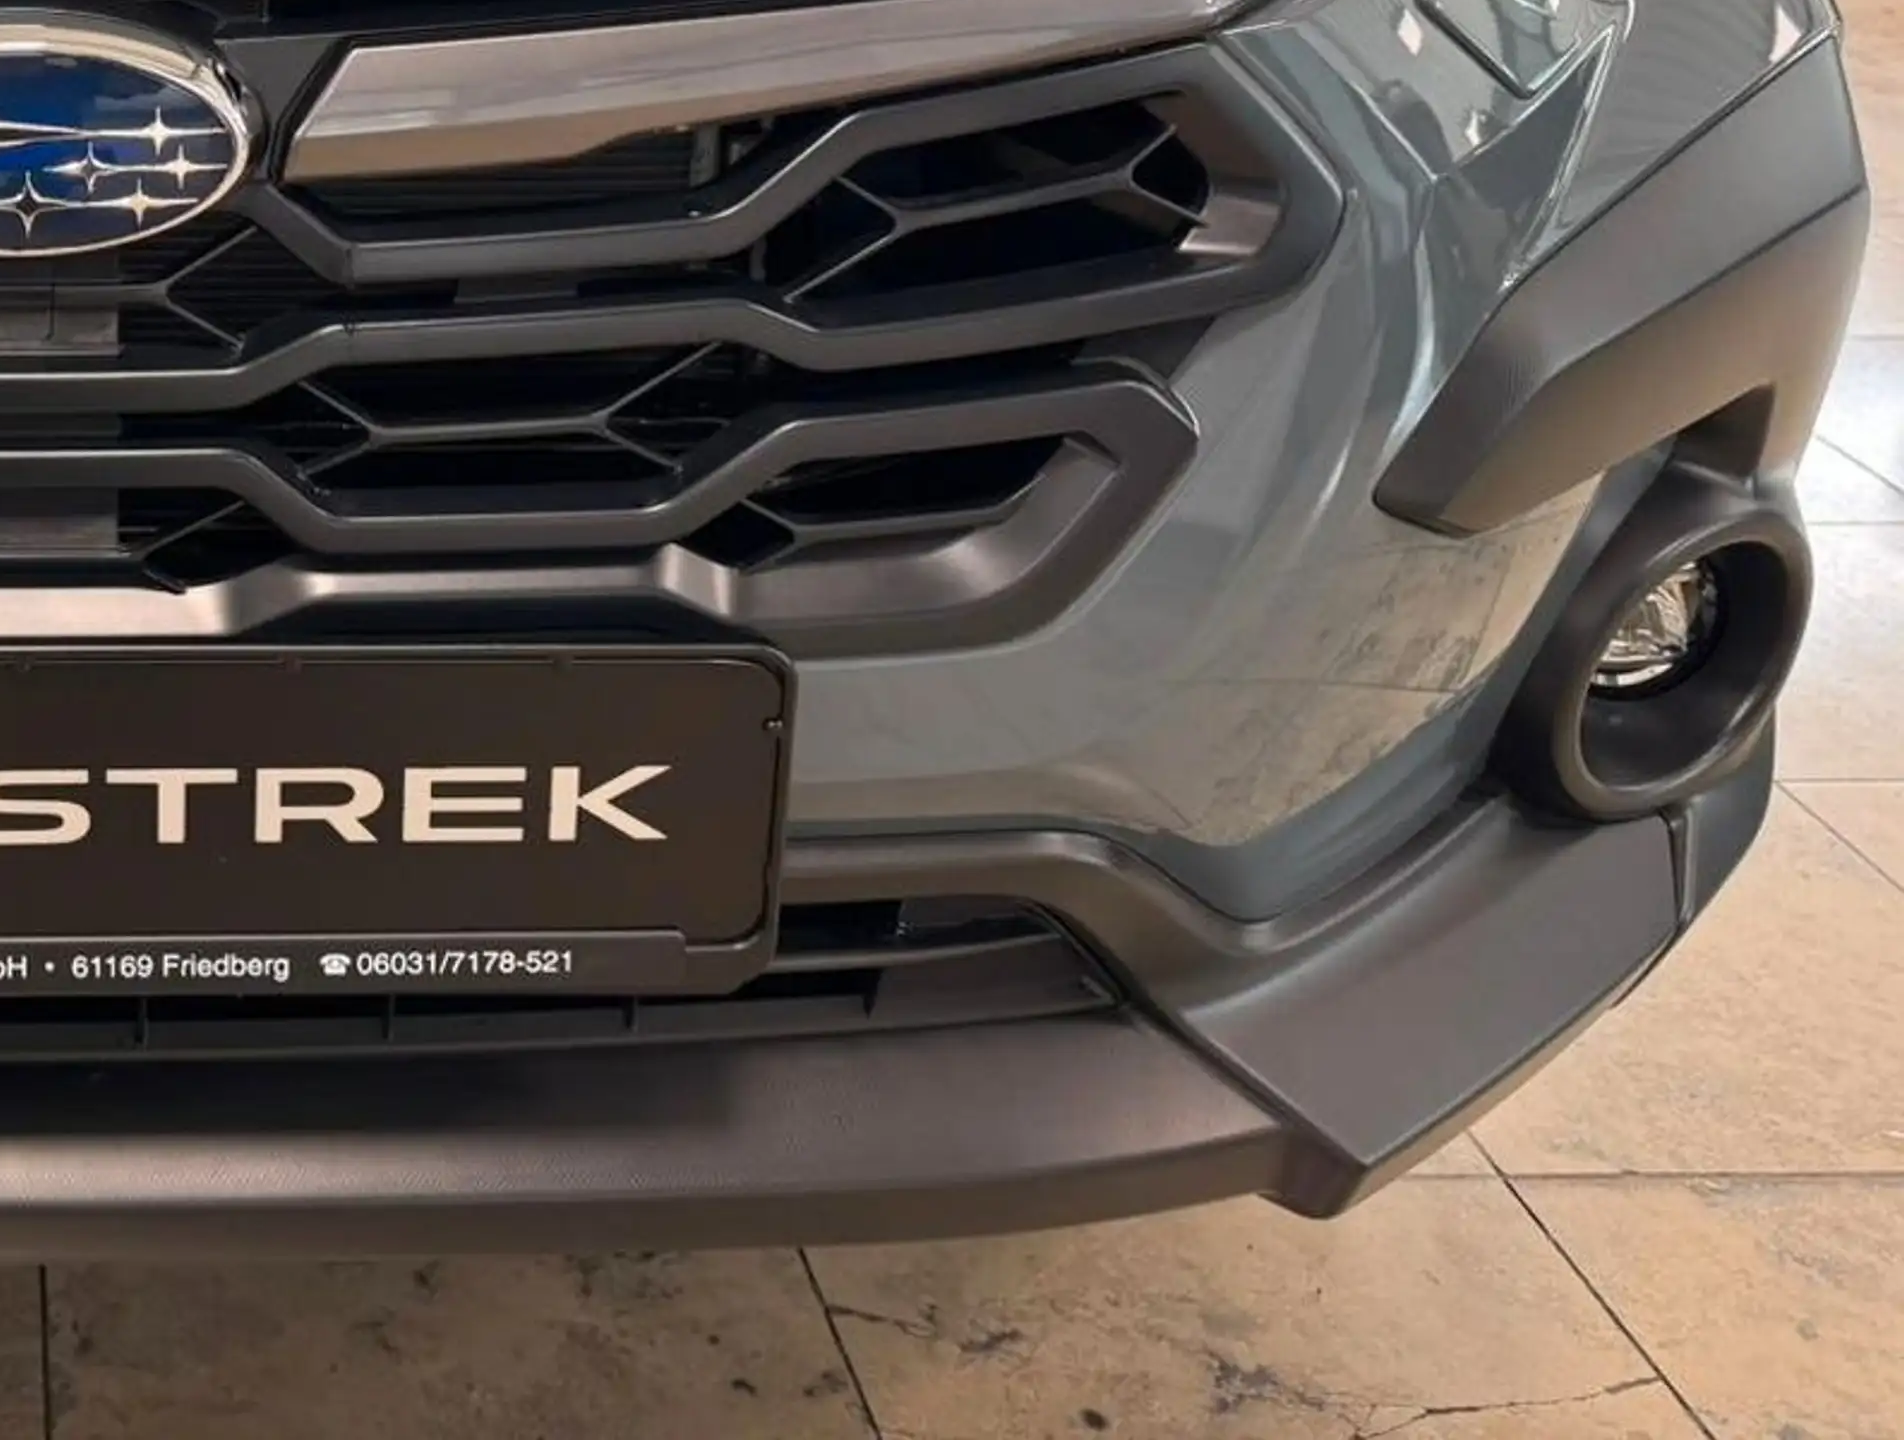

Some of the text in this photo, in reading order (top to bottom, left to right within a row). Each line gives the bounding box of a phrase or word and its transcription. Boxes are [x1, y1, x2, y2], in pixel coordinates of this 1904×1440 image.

[71, 954, 154, 979] 61169
[162, 953, 291, 984] Friedberg
[356, 950, 572, 976] 06031/7178-521
